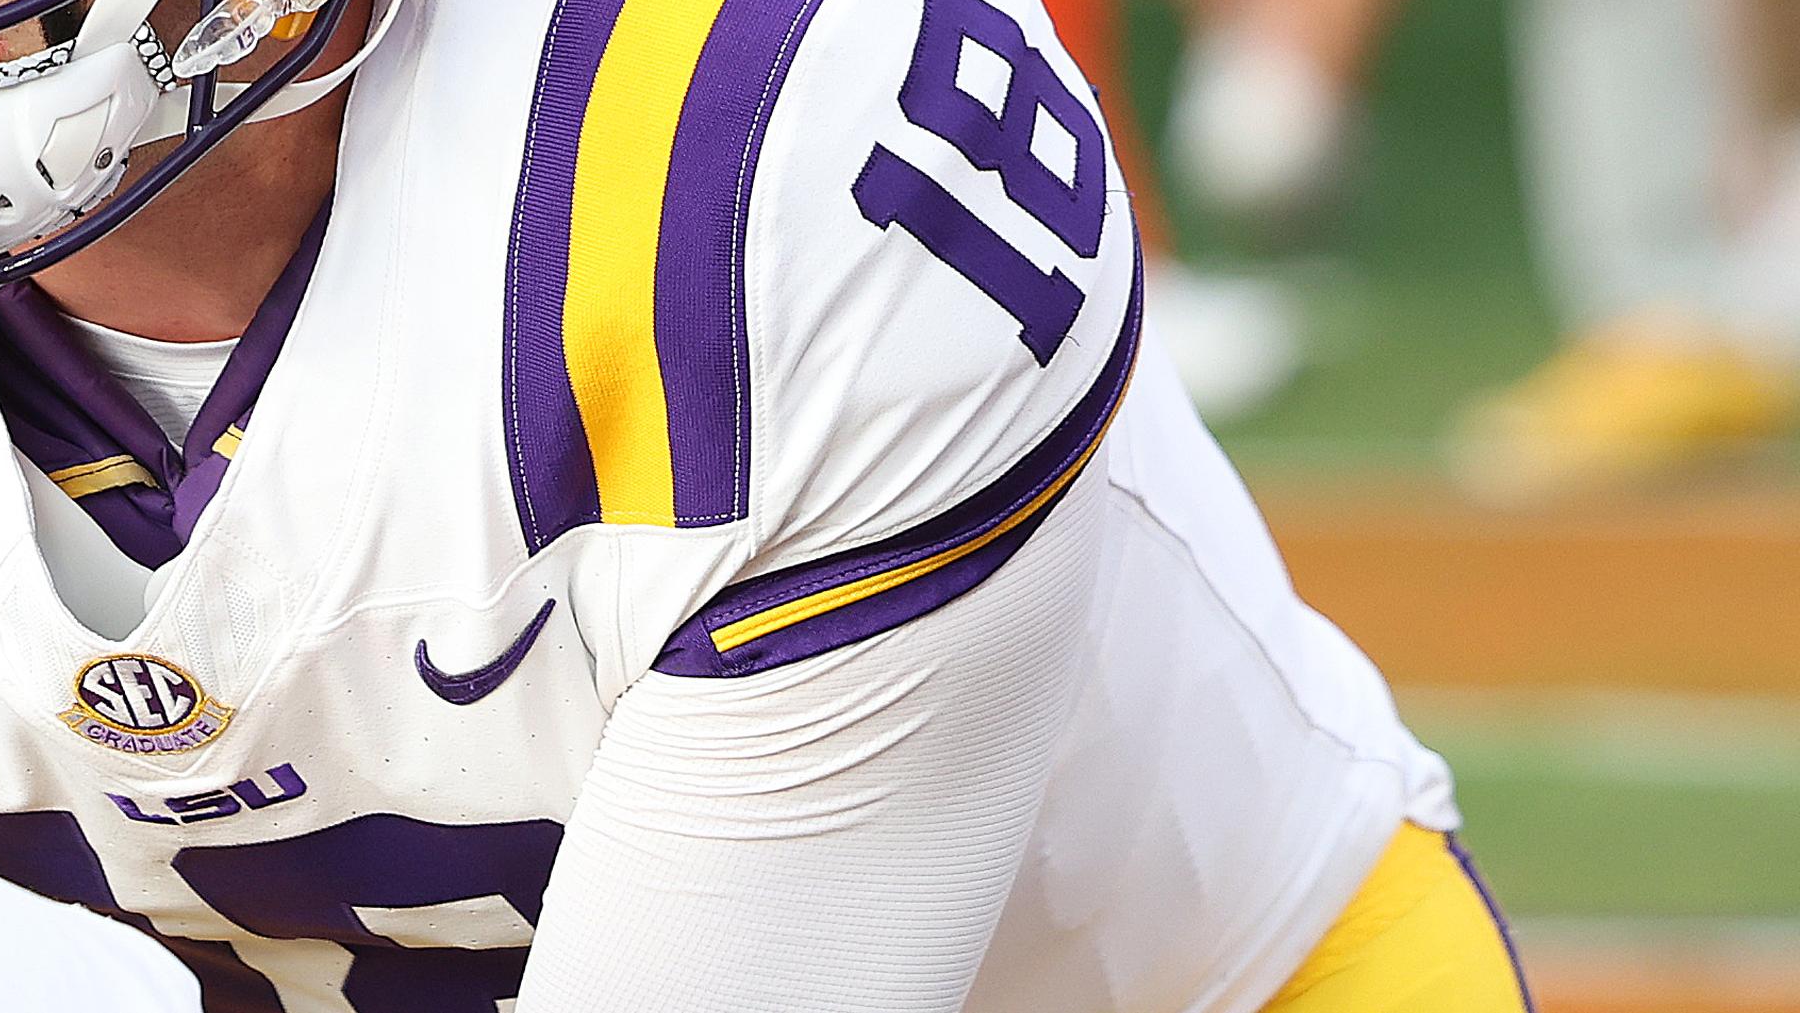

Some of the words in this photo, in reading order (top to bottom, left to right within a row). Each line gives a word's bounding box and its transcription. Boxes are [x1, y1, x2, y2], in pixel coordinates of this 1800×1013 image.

[81, 656, 192, 729] SEC
[86, 718, 217, 754] GRADUATE
[103, 762, 308, 826] LSU
